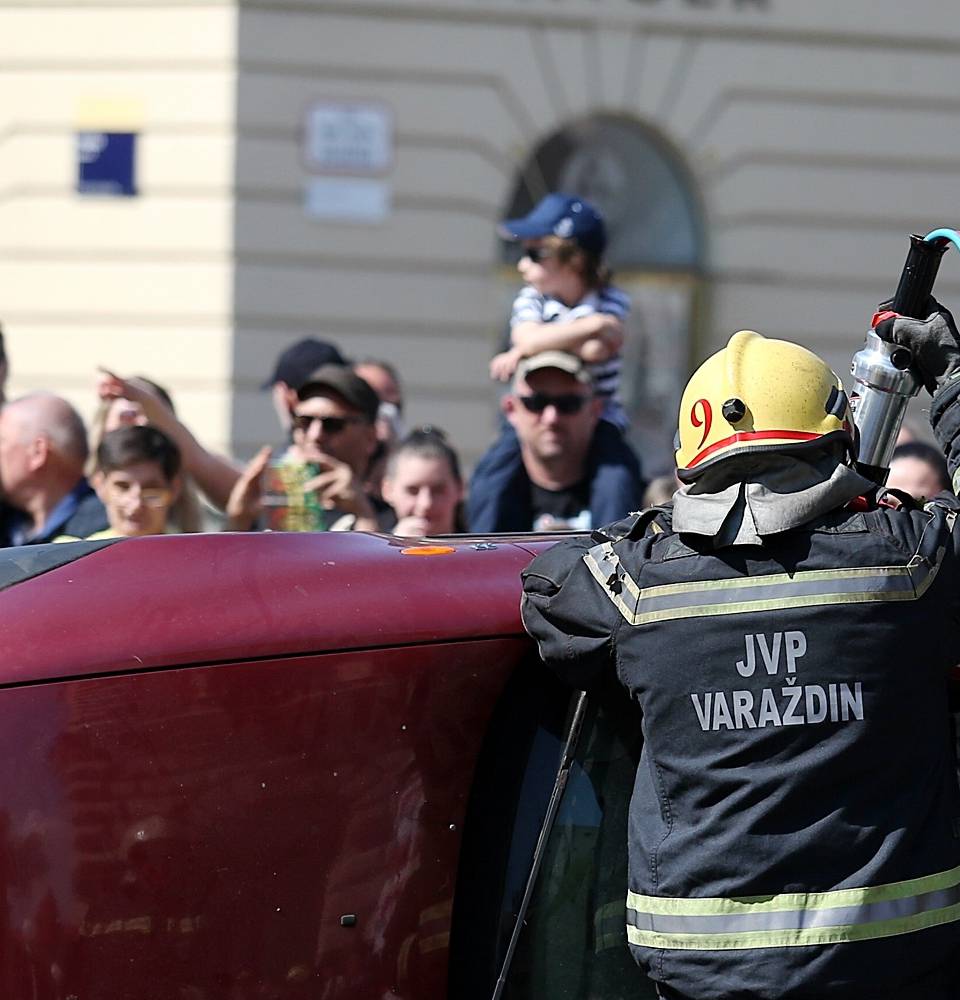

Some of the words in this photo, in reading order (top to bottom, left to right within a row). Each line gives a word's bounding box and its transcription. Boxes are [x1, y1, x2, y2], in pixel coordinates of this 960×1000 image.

[691, 399, 712, 450] 9
[735, 630, 807, 678] JVP
[690, 676, 865, 731] VARAŽDIN
